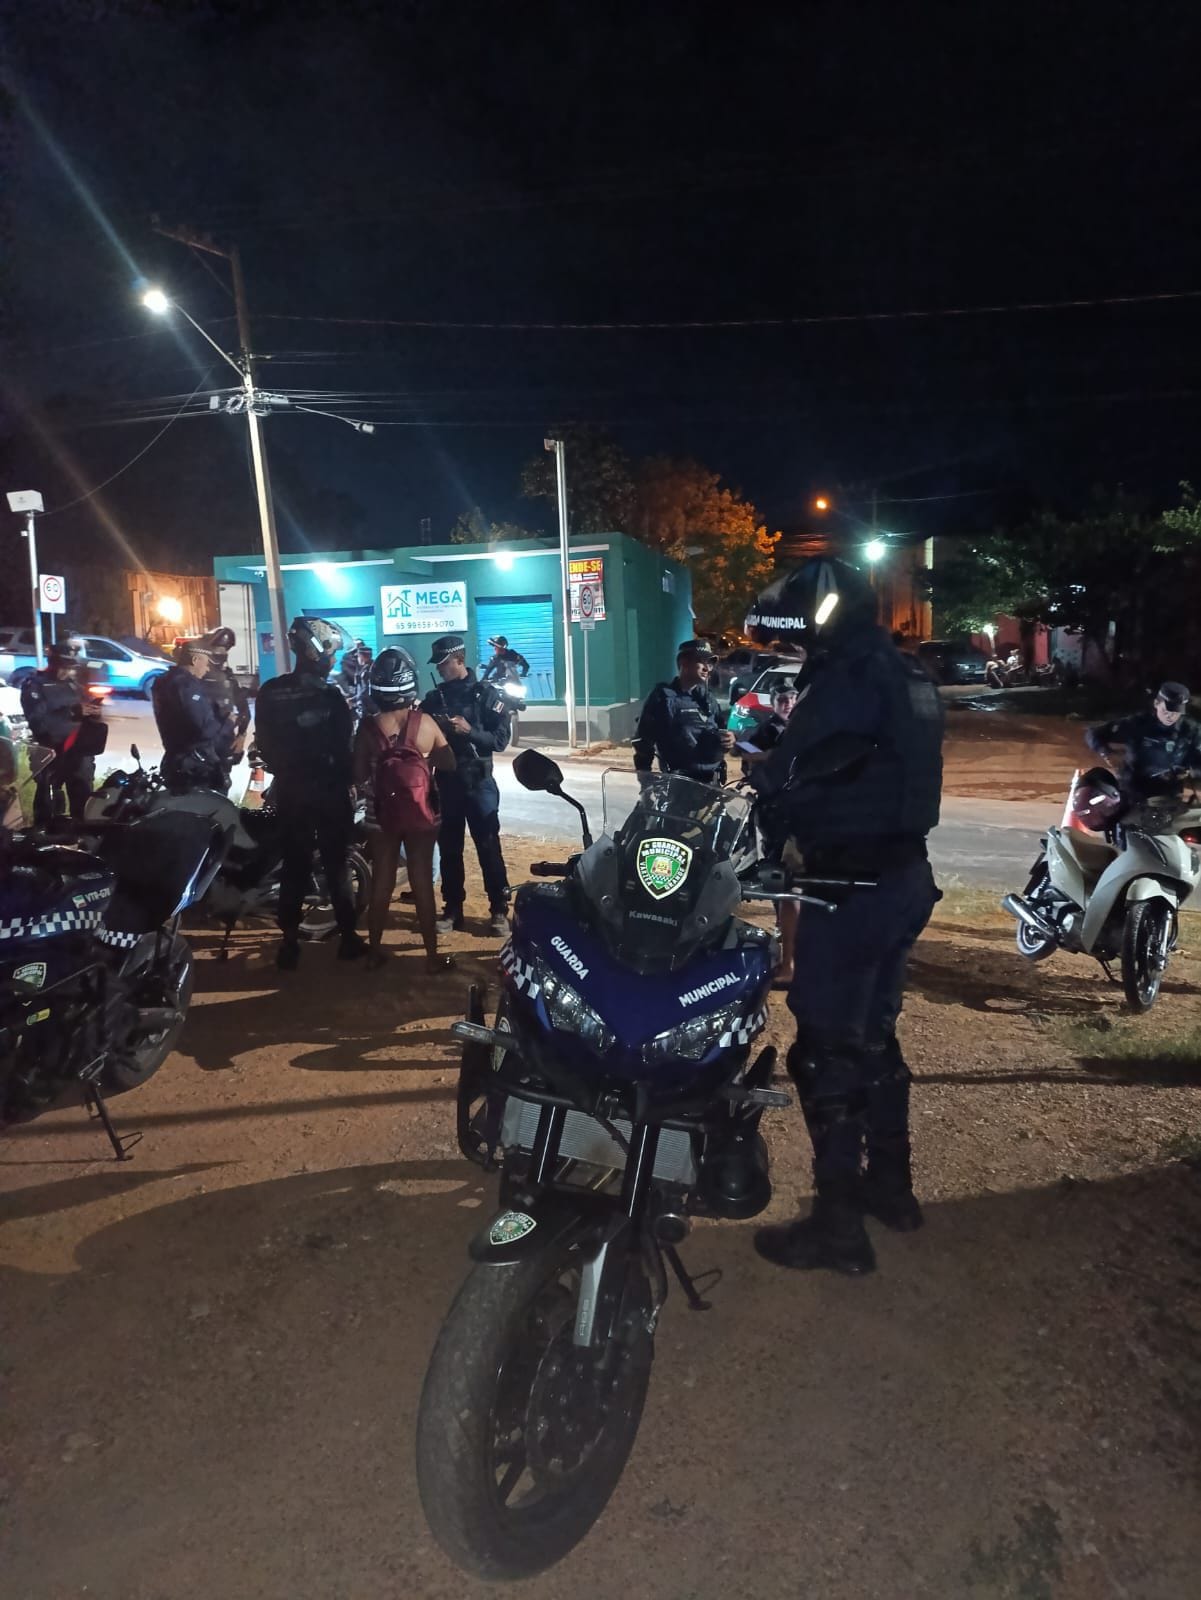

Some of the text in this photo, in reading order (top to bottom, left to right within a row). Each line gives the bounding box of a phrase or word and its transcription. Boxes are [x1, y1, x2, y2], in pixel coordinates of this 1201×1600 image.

[568, 560, 602, 574] ENDE-SE
[416, 590, 463, 605] MEGA
[760, 615, 807, 630] MUNICIPAL
[651, 841, 680, 852] GUARDA
[641, 847, 686, 865] MUNICIPAL
[629, 910, 678, 926] Kawasaki
[550, 935, 589, 980] GUARDA
[678, 971, 741, 1008] MUNICIPAL
